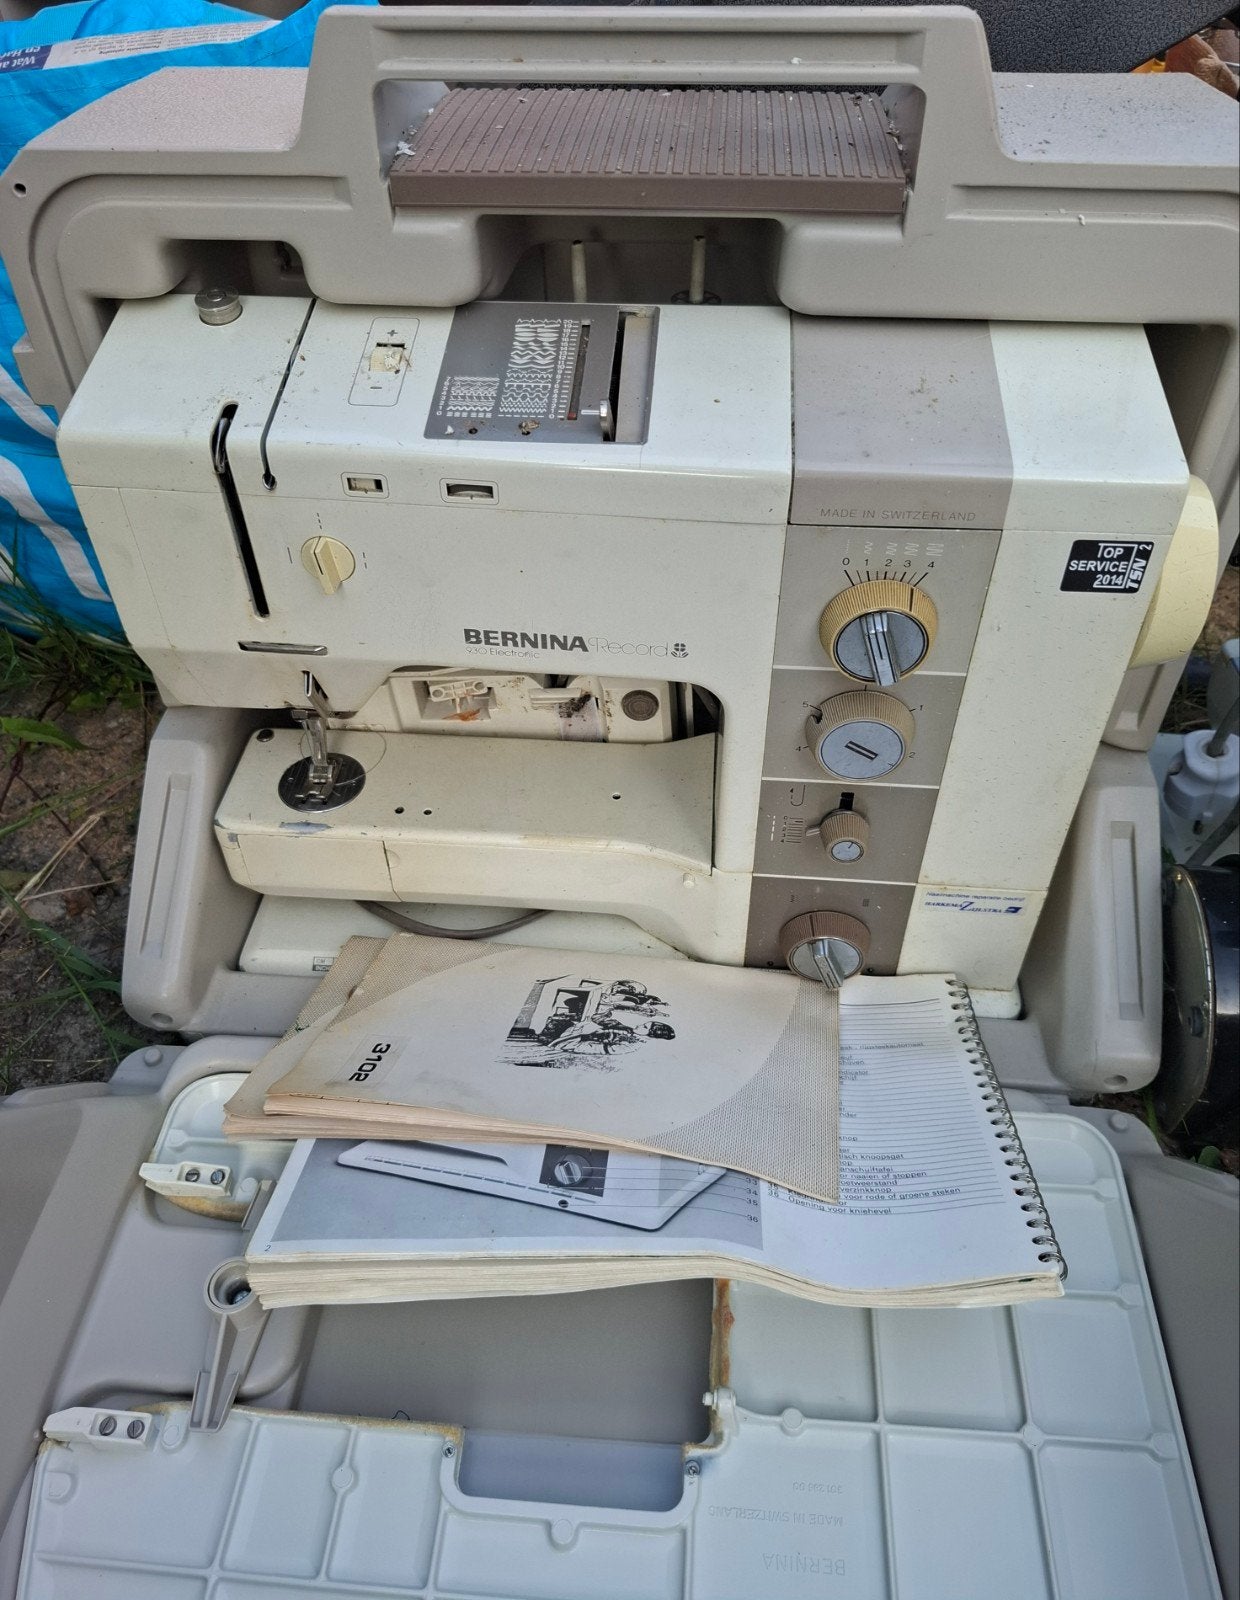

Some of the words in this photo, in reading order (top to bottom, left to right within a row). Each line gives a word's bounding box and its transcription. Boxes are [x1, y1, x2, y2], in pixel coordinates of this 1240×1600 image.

[11, 56, 36, 67] Wat
[820, 507, 857, 520] MADE
[861, 509, 876, 520] IN
[880, 509, 977, 523] SWITZERLAND
[1097, 543, 1124, 559] TOP
[841, 557, 850, 567] 0
[864, 559, 869, 567] 1
[884, 558, 893, 567] 2
[903, 559, 912, 568] 3
[926, 560, 936, 569] 4
[1068, 560, 1128, 572] SERVICE
[1125, 558, 1147, 589] TSN
[1095, 574, 1124, 586] 2014
[463, 628, 589, 653] BERNINA
[588, 636, 668, 657] Record
[489, 647, 541, 659] Electronic
[348, 1042, 392, 1083] 3102
[745, 1187, 758, 1196] 34
[932, 1187, 961, 1197] steken
[746, 1214, 759, 1223] 36
[264, 1244, 272, 1252] 2
[762, 1552, 846, 1577] BERNINA
